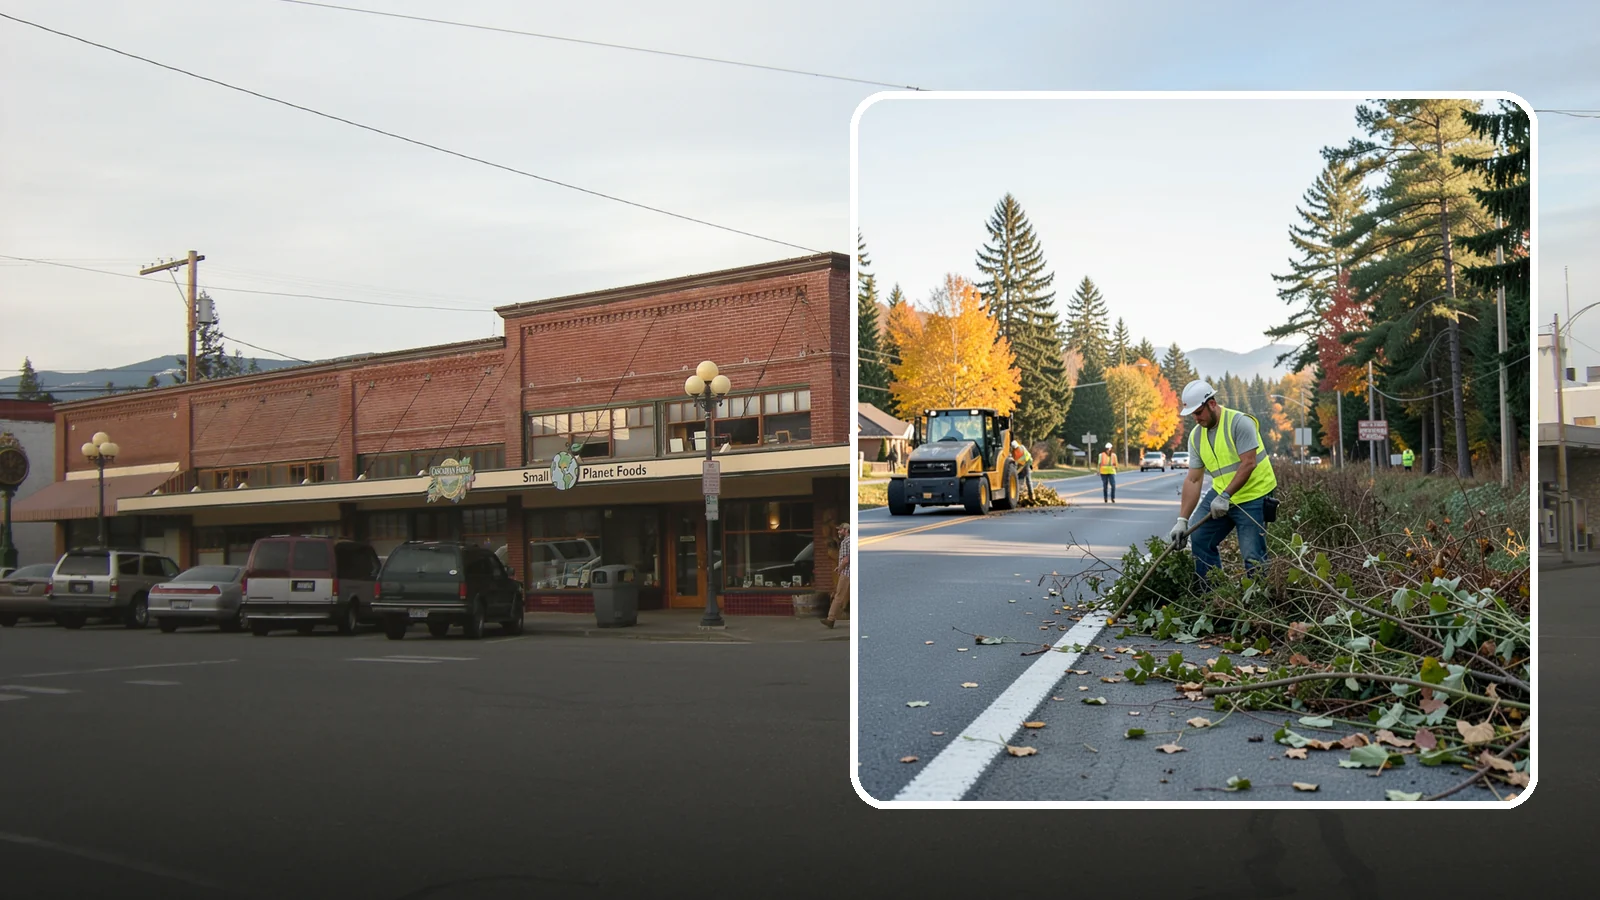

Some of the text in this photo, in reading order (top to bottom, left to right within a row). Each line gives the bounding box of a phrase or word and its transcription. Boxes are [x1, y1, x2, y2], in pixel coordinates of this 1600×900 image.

[523, 465, 647, 483] Small Planet Foods
